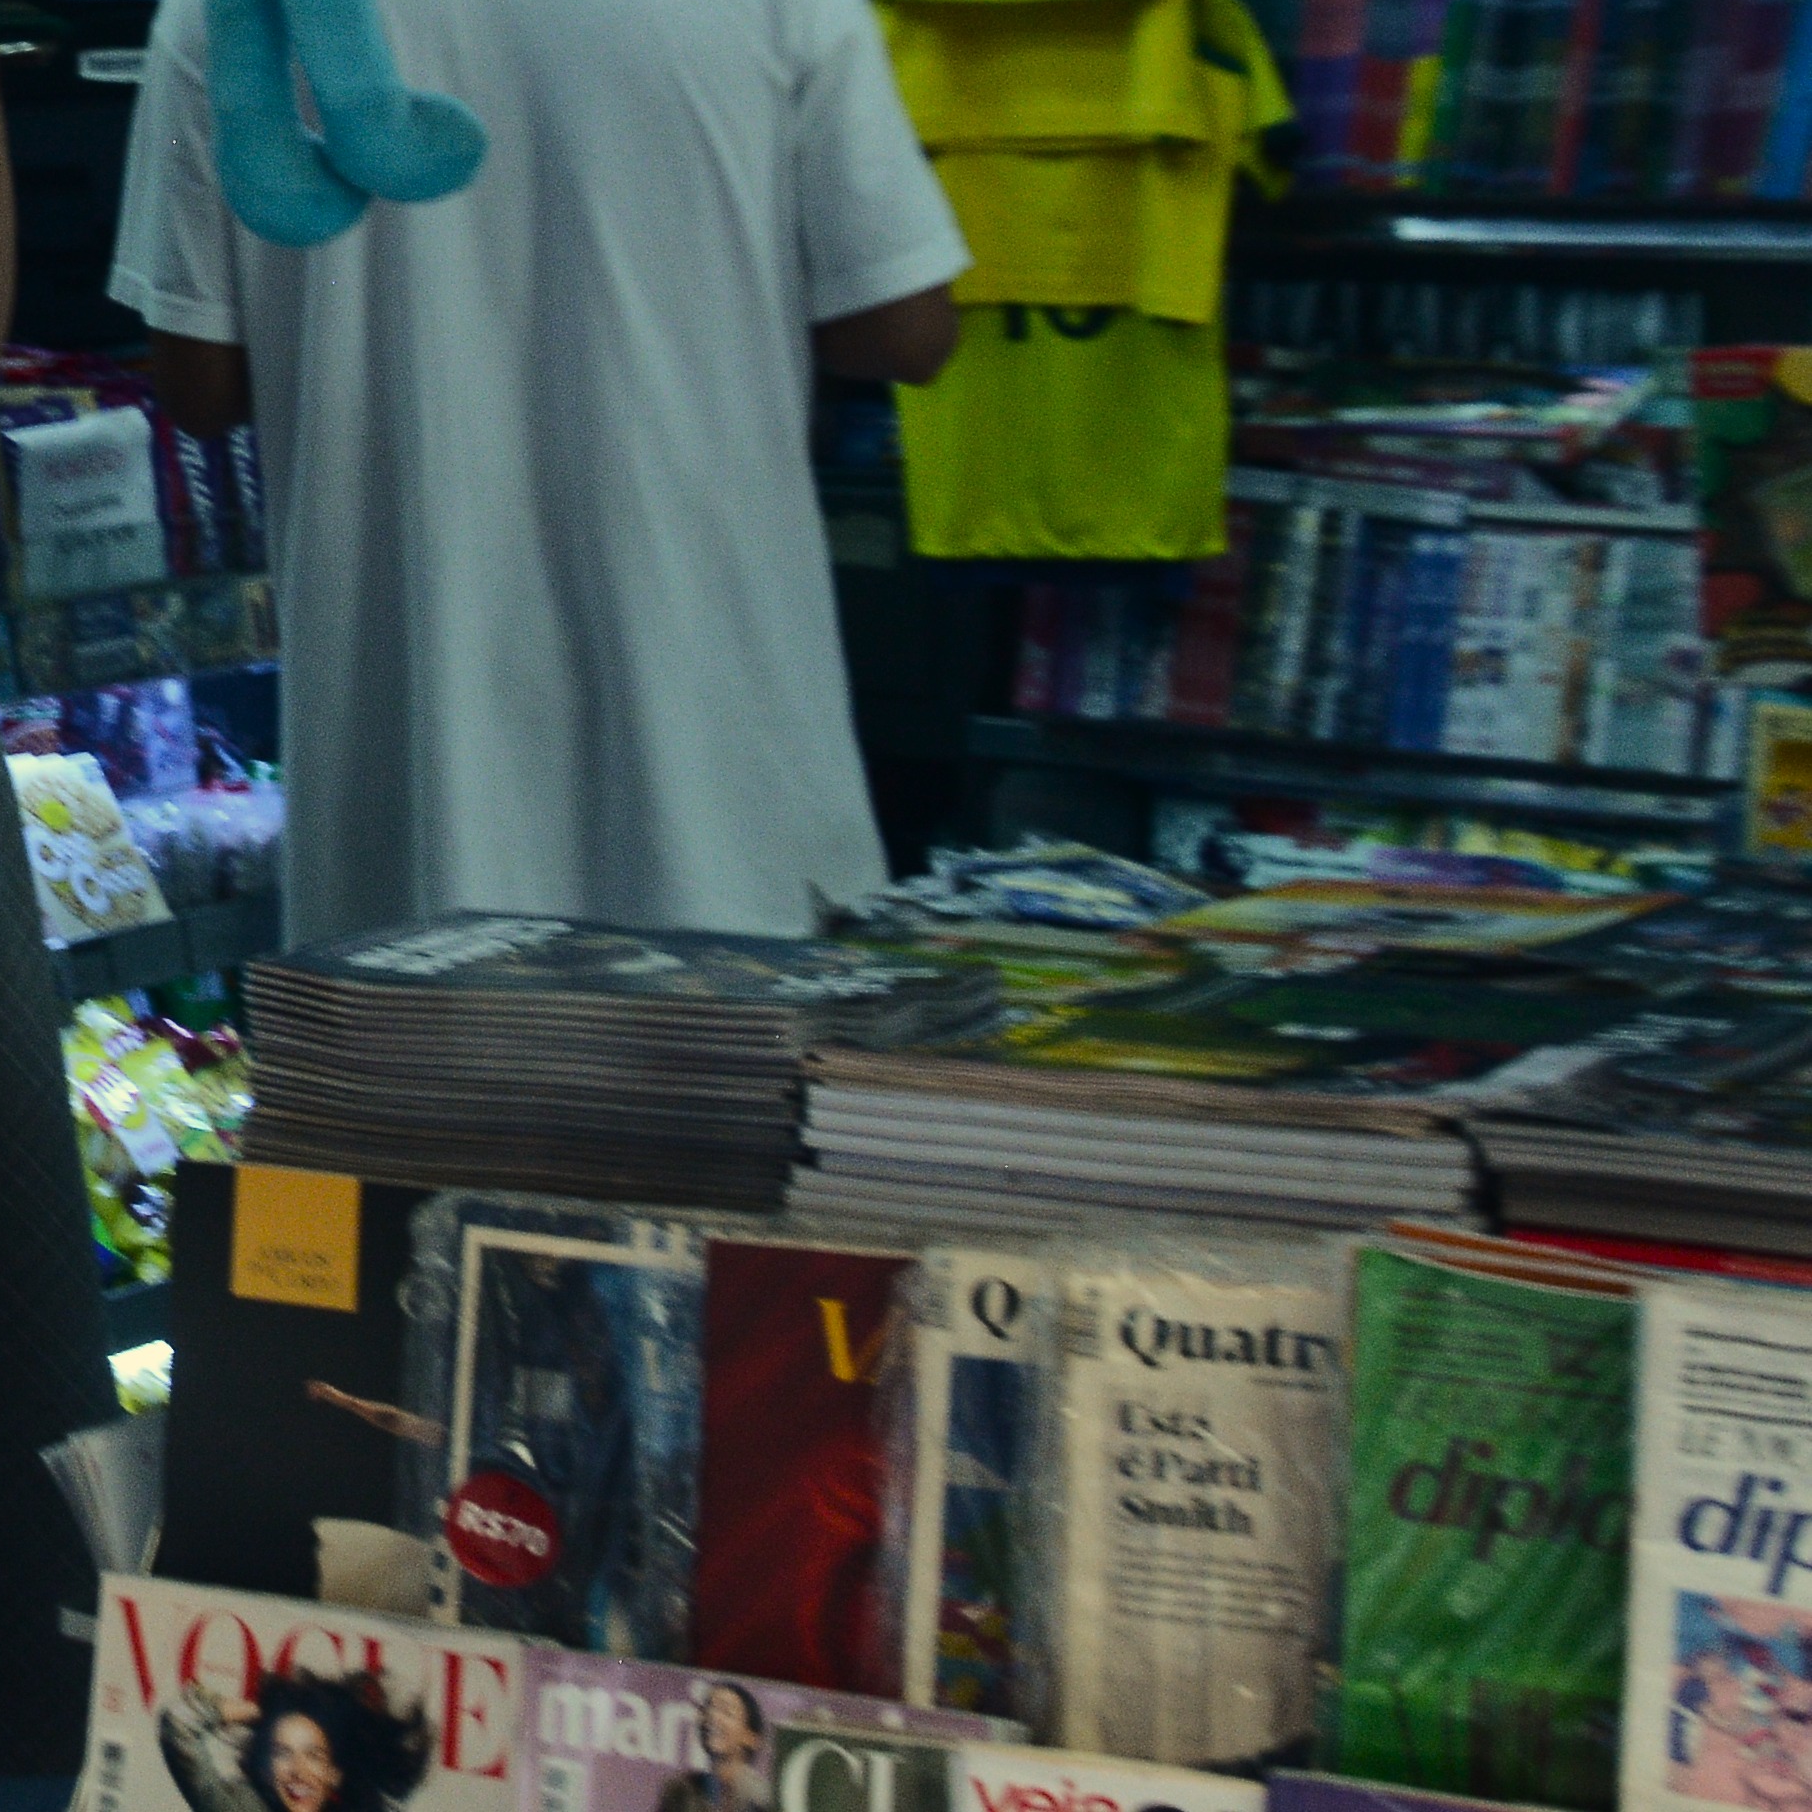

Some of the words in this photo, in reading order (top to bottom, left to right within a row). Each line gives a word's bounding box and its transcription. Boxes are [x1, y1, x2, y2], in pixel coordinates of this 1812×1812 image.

[1120, 1306, 1338, 1372] Quatr
[1147, 1451, 1262, 1493] Patti
[1387, 1435, 1638, 1564] diplo
[1119, 1495, 1254, 1537] Smith
[114, 1596, 507, 1779] VOE
[535, 1677, 714, 1774] mari
